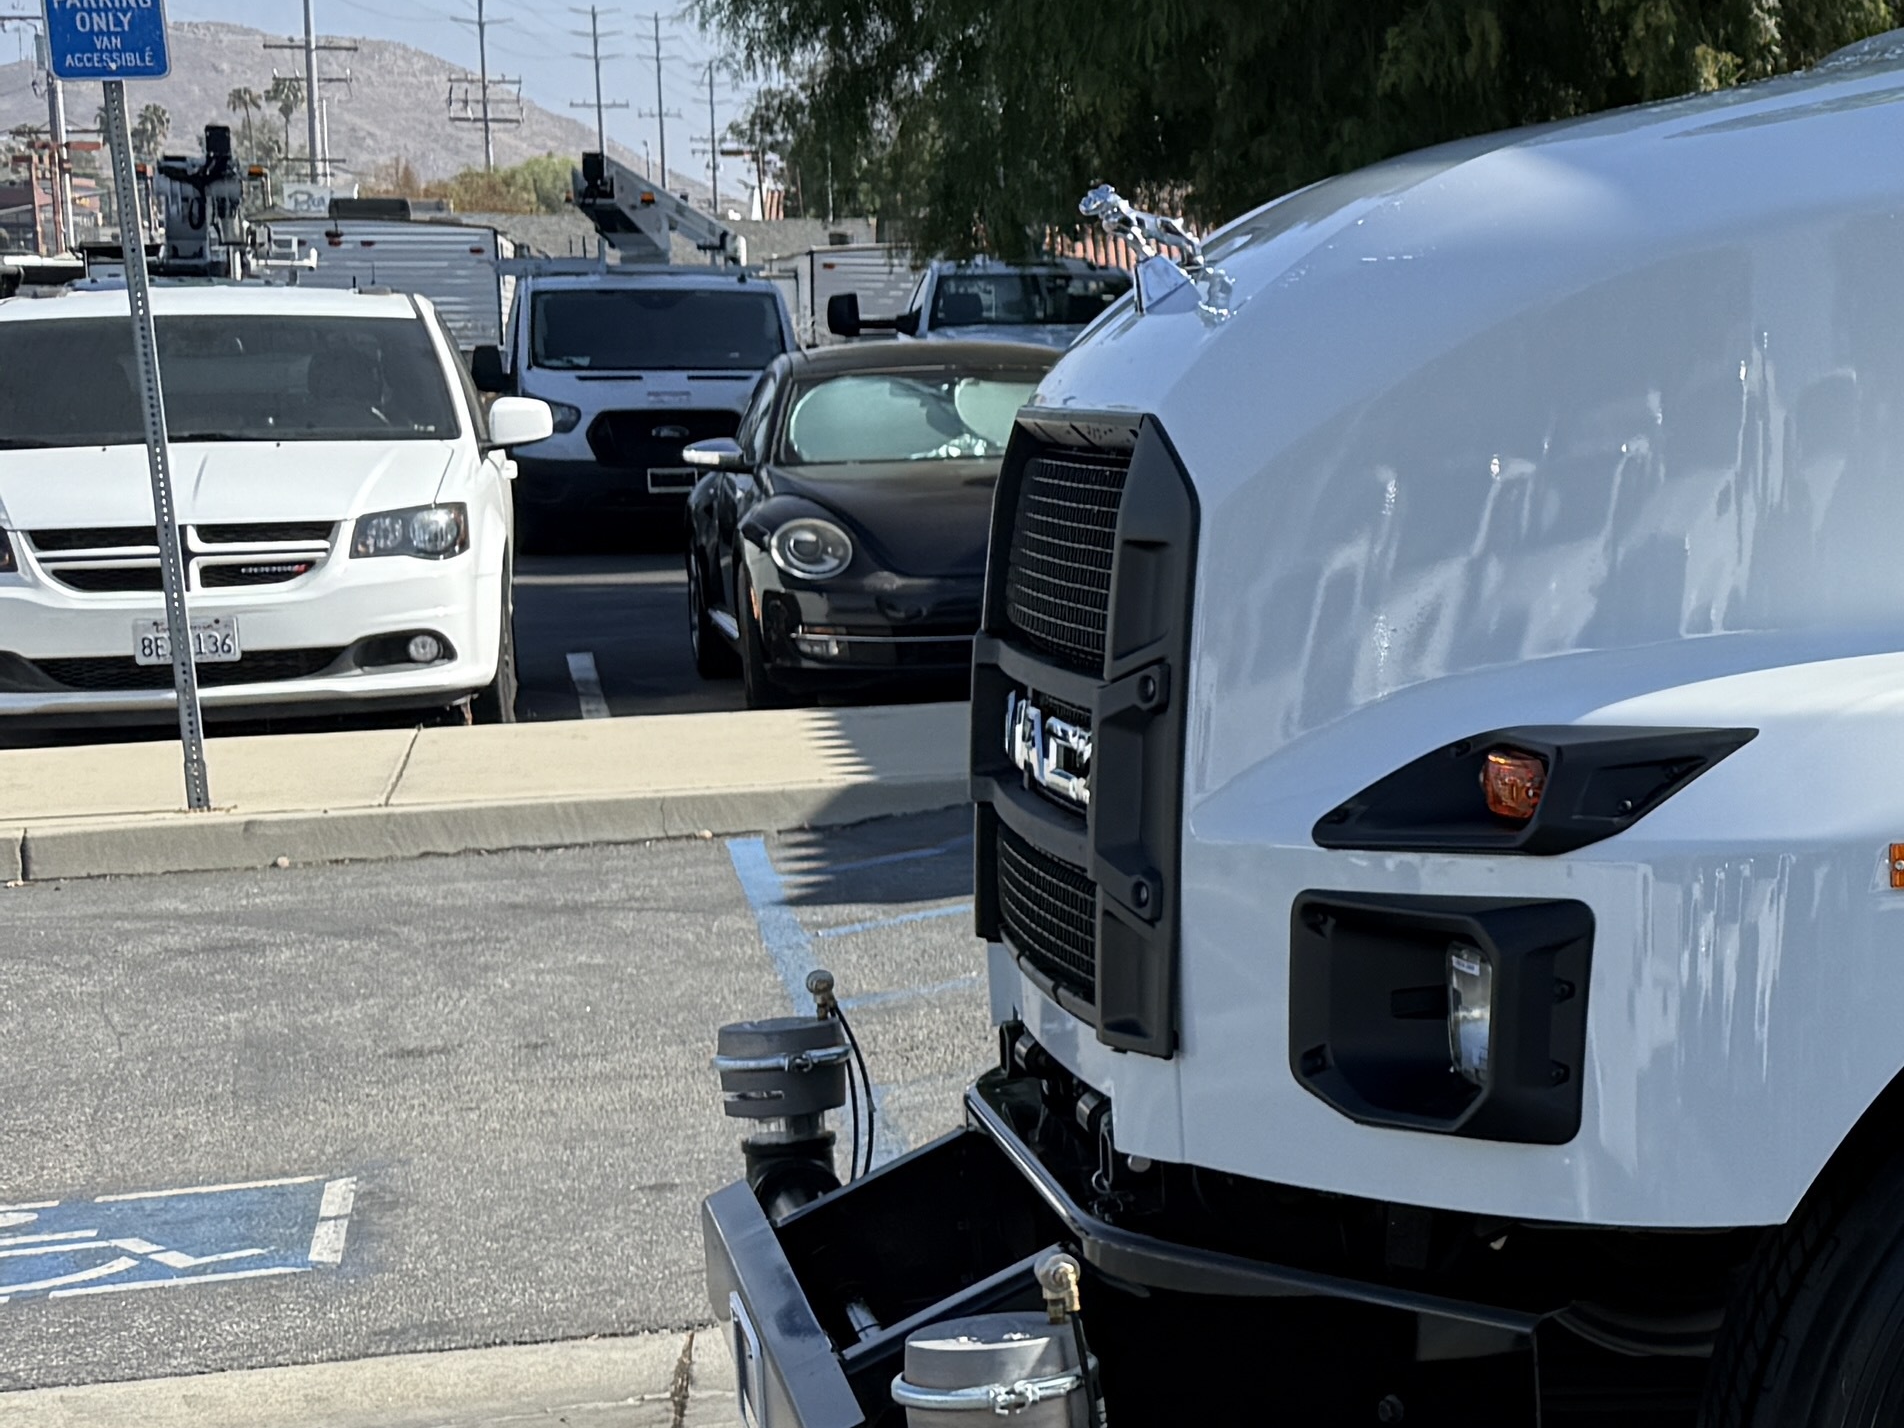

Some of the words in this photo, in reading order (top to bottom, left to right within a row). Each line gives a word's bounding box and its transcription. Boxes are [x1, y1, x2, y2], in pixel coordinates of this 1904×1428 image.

[75, 11, 132, 33] ONLY
[93, 35, 122, 50] VAN
[65, 51, 154, 68] ACCESSIBLE
[141, 633, 233, 659] 8E136
